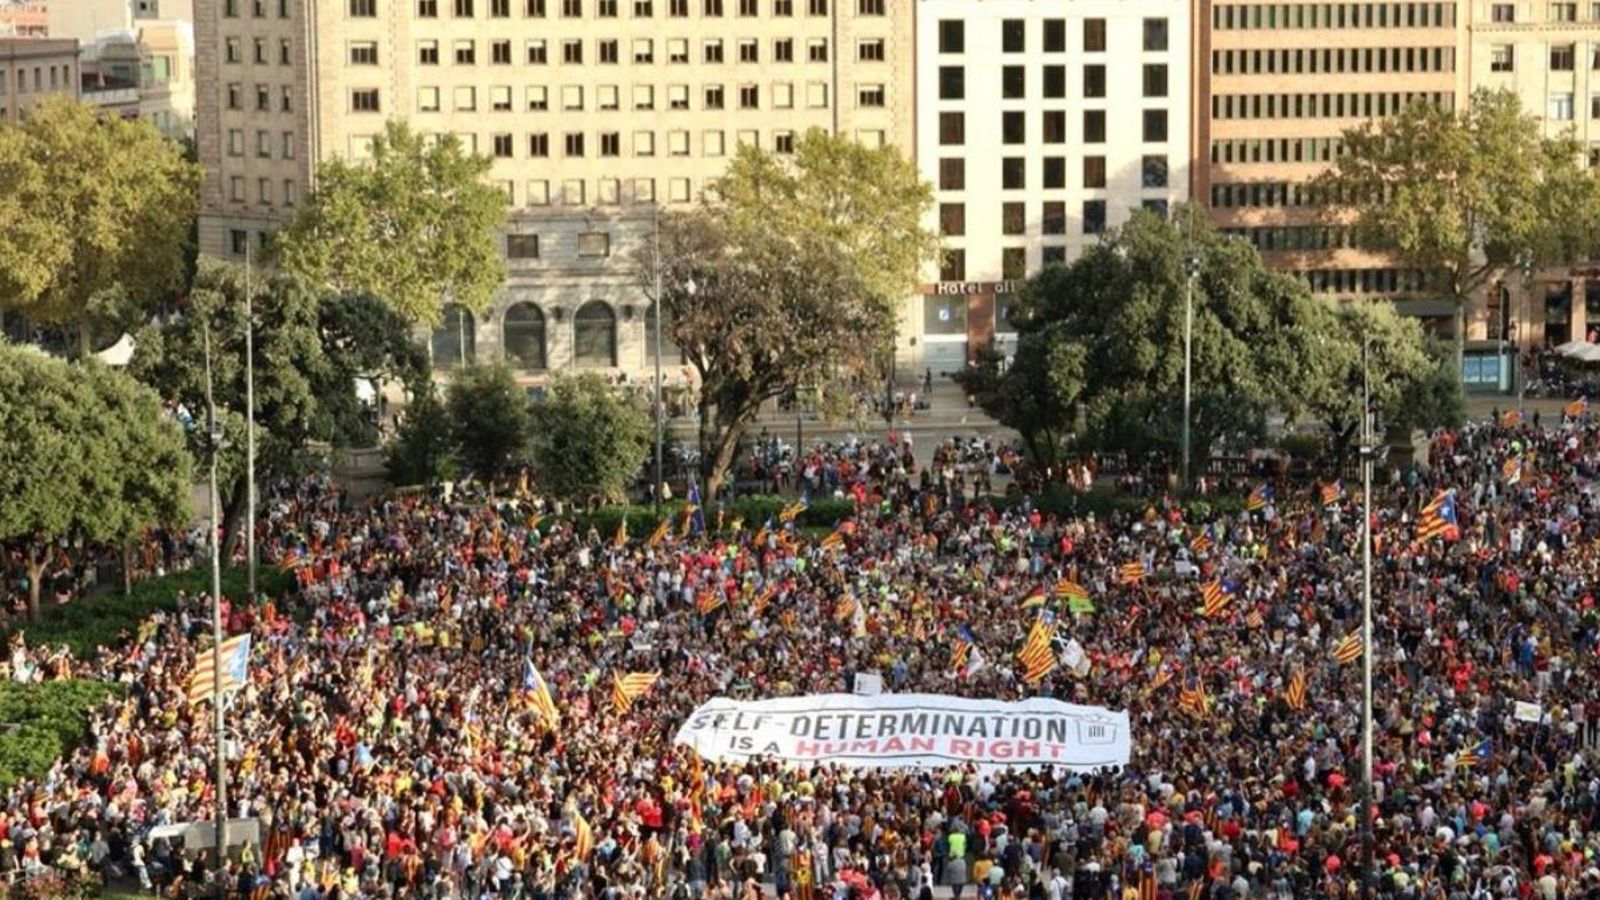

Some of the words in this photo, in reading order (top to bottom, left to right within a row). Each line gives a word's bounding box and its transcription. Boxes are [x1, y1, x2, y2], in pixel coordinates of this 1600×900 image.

[937, 281, 982, 295] Hotel
[691, 712, 1067, 743] SELF-DETERMINATION
[729, 736, 754, 750] IS
[763, 741, 781, 754] A
[795, 737, 935, 757] HUMAN
[950, 741, 1067, 759] RIGHT
